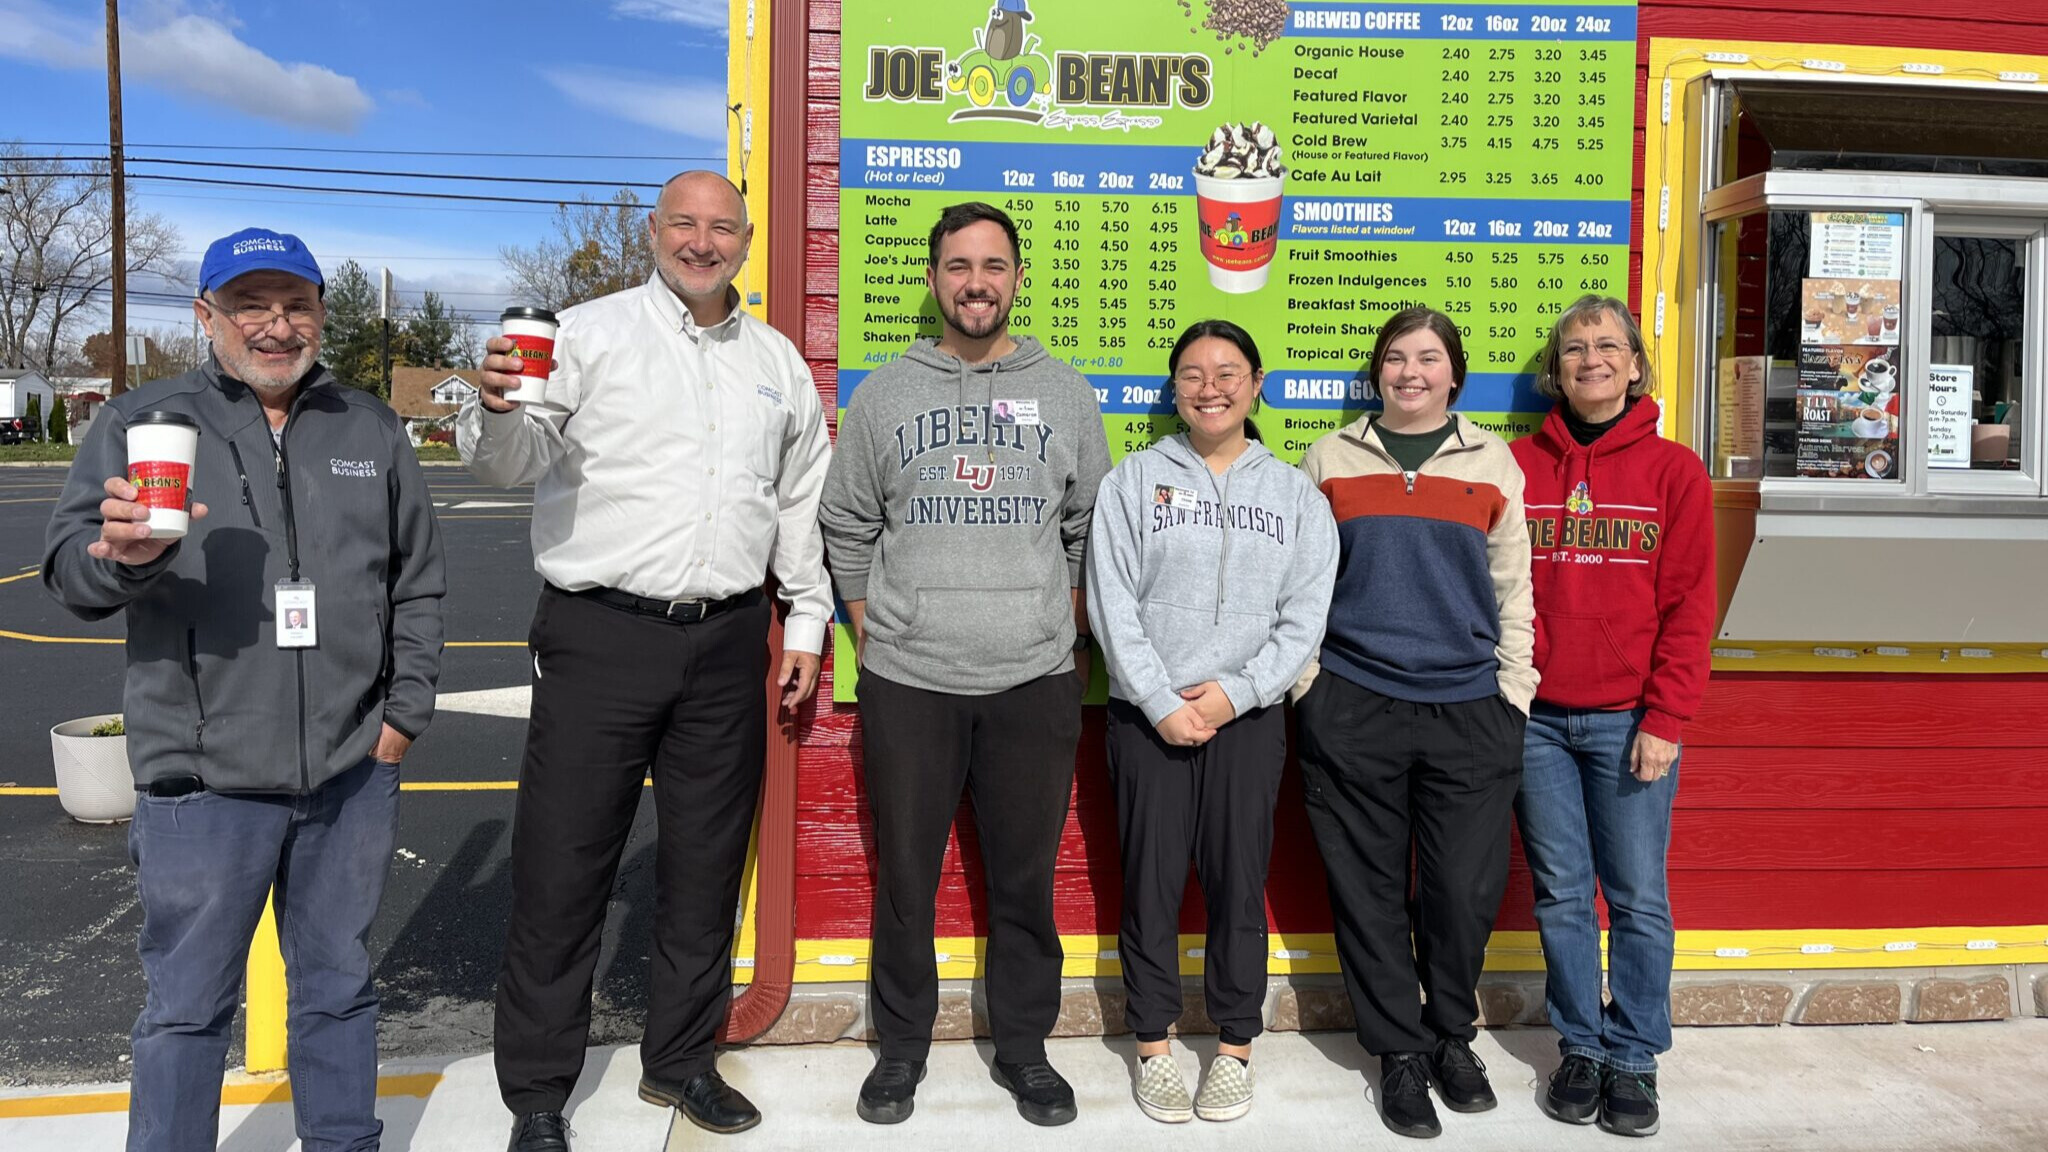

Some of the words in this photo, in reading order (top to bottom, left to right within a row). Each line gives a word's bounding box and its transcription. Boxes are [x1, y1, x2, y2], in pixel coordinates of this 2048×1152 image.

[1294, 11, 1360, 29] BREWED
[1365, 12, 1420, 29] COFFEE
[1441, 15, 1473, 31] 12oz
[1486, 15, 1518, 31] 16oz
[1531, 16, 1566, 32] 20oz
[1576, 16, 1610, 32] 24oz
[1295, 45, 1353, 60] Organic
[1359, 46, 1404, 58] House
[1443, 48, 1469, 59] 2.40
[1489, 49, 1515, 60] 2.75
[1535, 49, 1561, 60] 3.20
[1580, 50, 1606, 60] 3.45
[866, 48, 944, 101] JOE
[1056, 52, 1211, 108] BEAN'S
[1294, 67, 1337, 79] Decaf
[1442, 70, 1469, 81] 2.40
[1489, 71, 1514, 82] 2.75
[1535, 72, 1561, 83] 3.20
[1579, 72, 1606, 83] 3.45
[1294, 90, 1357, 102] Featured
[1363, 91, 1407, 102] Flavor
[1442, 93, 1468, 103] 2.40
[1488, 93, 1513, 104] 2.75
[1534, 94, 1560, 105] 3.20
[1579, 94, 1605, 105] 3.45
[1102, 111, 1160, 130] Espresso
[1293, 112, 1357, 124] Featured
[1362, 113, 1417, 125] Varietal
[1441, 115, 1468, 126] 2.40
[1488, 115, 1513, 126] 2.75
[1533, 116, 1559, 127] 3.20
[1578, 117, 1604, 127] 3.45
[1292, 134, 1327, 146] Cold
[1333, 135, 1367, 146] Brew
[1441, 137, 1466, 148] 3.75
[1487, 138, 1512, 148] 4.15
[1532, 139, 1558, 149] 4.75
[1578, 139, 1603, 150] 5.25
[867, 146, 960, 168] ESPRESSO
[1292, 151, 1328, 160] (House
[1345, 151, 1389, 160] Featured
[1393, 152, 1428, 162] Flavor)
[865, 170, 893, 183] (Hot
[896, 174, 910, 182] or
[913, 172, 944, 185] Iced)
[1003, 170, 1034, 186] 12oz
[1052, 171, 1084, 187] 16oz
[1099, 172, 1133, 188] 20oz
[1150, 173, 1183, 189] 24oz
[1291, 170, 1326, 181] Cafe
[1331, 170, 1350, 181] Au
[1356, 171, 1381, 182] Lait
[1440, 172, 1466, 183] 2.95
[1486, 173, 1511, 184] 3.25
[1532, 173, 1558, 184] 3.65
[1575, 174, 1603, 185] 4.00
[866, 195, 910, 206] Mocha
[1005, 199, 1033, 211] 4.50
[1055, 201, 1080, 212] 5.10
[1103, 202, 1129, 213] 5.70
[1152, 203, 1177, 213] 6.15
[1294, 202, 1392, 222] SMOOTHIES
[866, 215, 897, 225] Latte
[1054, 220, 1079, 231] 4.10
[1101, 221, 1129, 232] 4.50
[1150, 222, 1177, 233] 4.95
[1292, 224, 1328, 233] Flavors
[1331, 225, 1359, 233] listed
[1361, 226, 1371, 234] at
[1374, 226, 1415, 234] window!
[1444, 219, 1476, 235] 12oz
[1488, 220, 1521, 236] 16oz
[1534, 221, 1568, 237] 20oz
[1578, 221, 1612, 237] 24oz
[233, 238, 283, 248] COMCAST
[233, 244, 286, 255] BUSINESS
[1054, 240, 1079, 250] 4.10
[1101, 240, 1128, 251] 4.50
[1150, 241, 1177, 252] 4.95
[865, 254, 897, 265] Joe's
[1053, 259, 1079, 270] 3.50
[1102, 260, 1127, 271] 3.75
[1150, 261, 1176, 271] 4.25
[1290, 249, 1319, 260] Fruit
[1324, 250, 1397, 261] Smoothies
[1446, 252, 1473, 263] 4.50
[1492, 253, 1518, 263] 5.25
[1539, 253, 1564, 264] 5.75
[1581, 254, 1608, 265] 6.50
[865, 274, 893, 284] Iced
[1052, 278, 1079, 289] 4.40
[1099, 279, 1127, 290] 4.90
[1149, 280, 1176, 291] 5.40
[1289, 274, 1333, 285] Frozen
[1339, 275, 1426, 289] Indulgences
[1447, 277, 1471, 287] 5.10
[1491, 277, 1517, 288] 5.80
[1538, 278, 1562, 289] 6.10
[1580, 279, 1607, 289] 6.80
[865, 293, 900, 304] Breve
[1051, 297, 1079, 308] 4.95
[1100, 298, 1126, 309] 5.45
[1149, 299, 1175, 310] 5.75
[1288, 299, 1355, 310] Breakfast
[1445, 301, 1471, 312] 5.25
[1490, 302, 1517, 313] 5.90
[1537, 303, 1561, 314] 6.15
[864, 313, 937, 325] Americano
[1052, 316, 1078, 327] 3.25
[1100, 317, 1126, 328] 3.95
[1147, 318, 1175, 329] 4.50
[1288, 323, 1336, 334] Protein
[1490, 327, 1516, 338] 5.20
[864, 332, 910, 342] Shaken
[1051, 336, 1078, 346] 5.05
[1100, 337, 1125, 347] 5.85
[1148, 338, 1174, 349] 6.25
[864, 352, 887, 363] Add
[1070, 356, 1087, 368] for
[1090, 357, 1123, 367] +0.80
[1287, 348, 1343, 361] Tropical
[1489, 352, 1515, 362] 5.80
[1930, 373, 1957, 381] Store
[1123, 386, 1160, 403] 20oz
[1285, 379, 1344, 399] BAKED
[1929, 384, 1957, 392] Hours
[1804, 407, 1831, 421] ROAST
[1125, 421, 1156, 435] 4.95
[1285, 419, 1335, 429] Brioche
[330, 458, 374, 468] COMCAST
[331, 467, 376, 477] BUSINESS
[919, 466, 949, 481] EST.
[953, 454, 997, 492] LU
[1000, 466, 1031, 481] 1971
[144, 478, 180, 488] BEAN'S
[904, 496, 1048, 525] UNIVERSITY
[1152, 504, 1186, 533] SAN
[1193, 501, 1283, 545] FRANCISCO
[1561, 516, 1660, 552] BEAN'S
[1552, 552, 1571, 562] EST.
[1575, 554, 1602, 564] 2000
